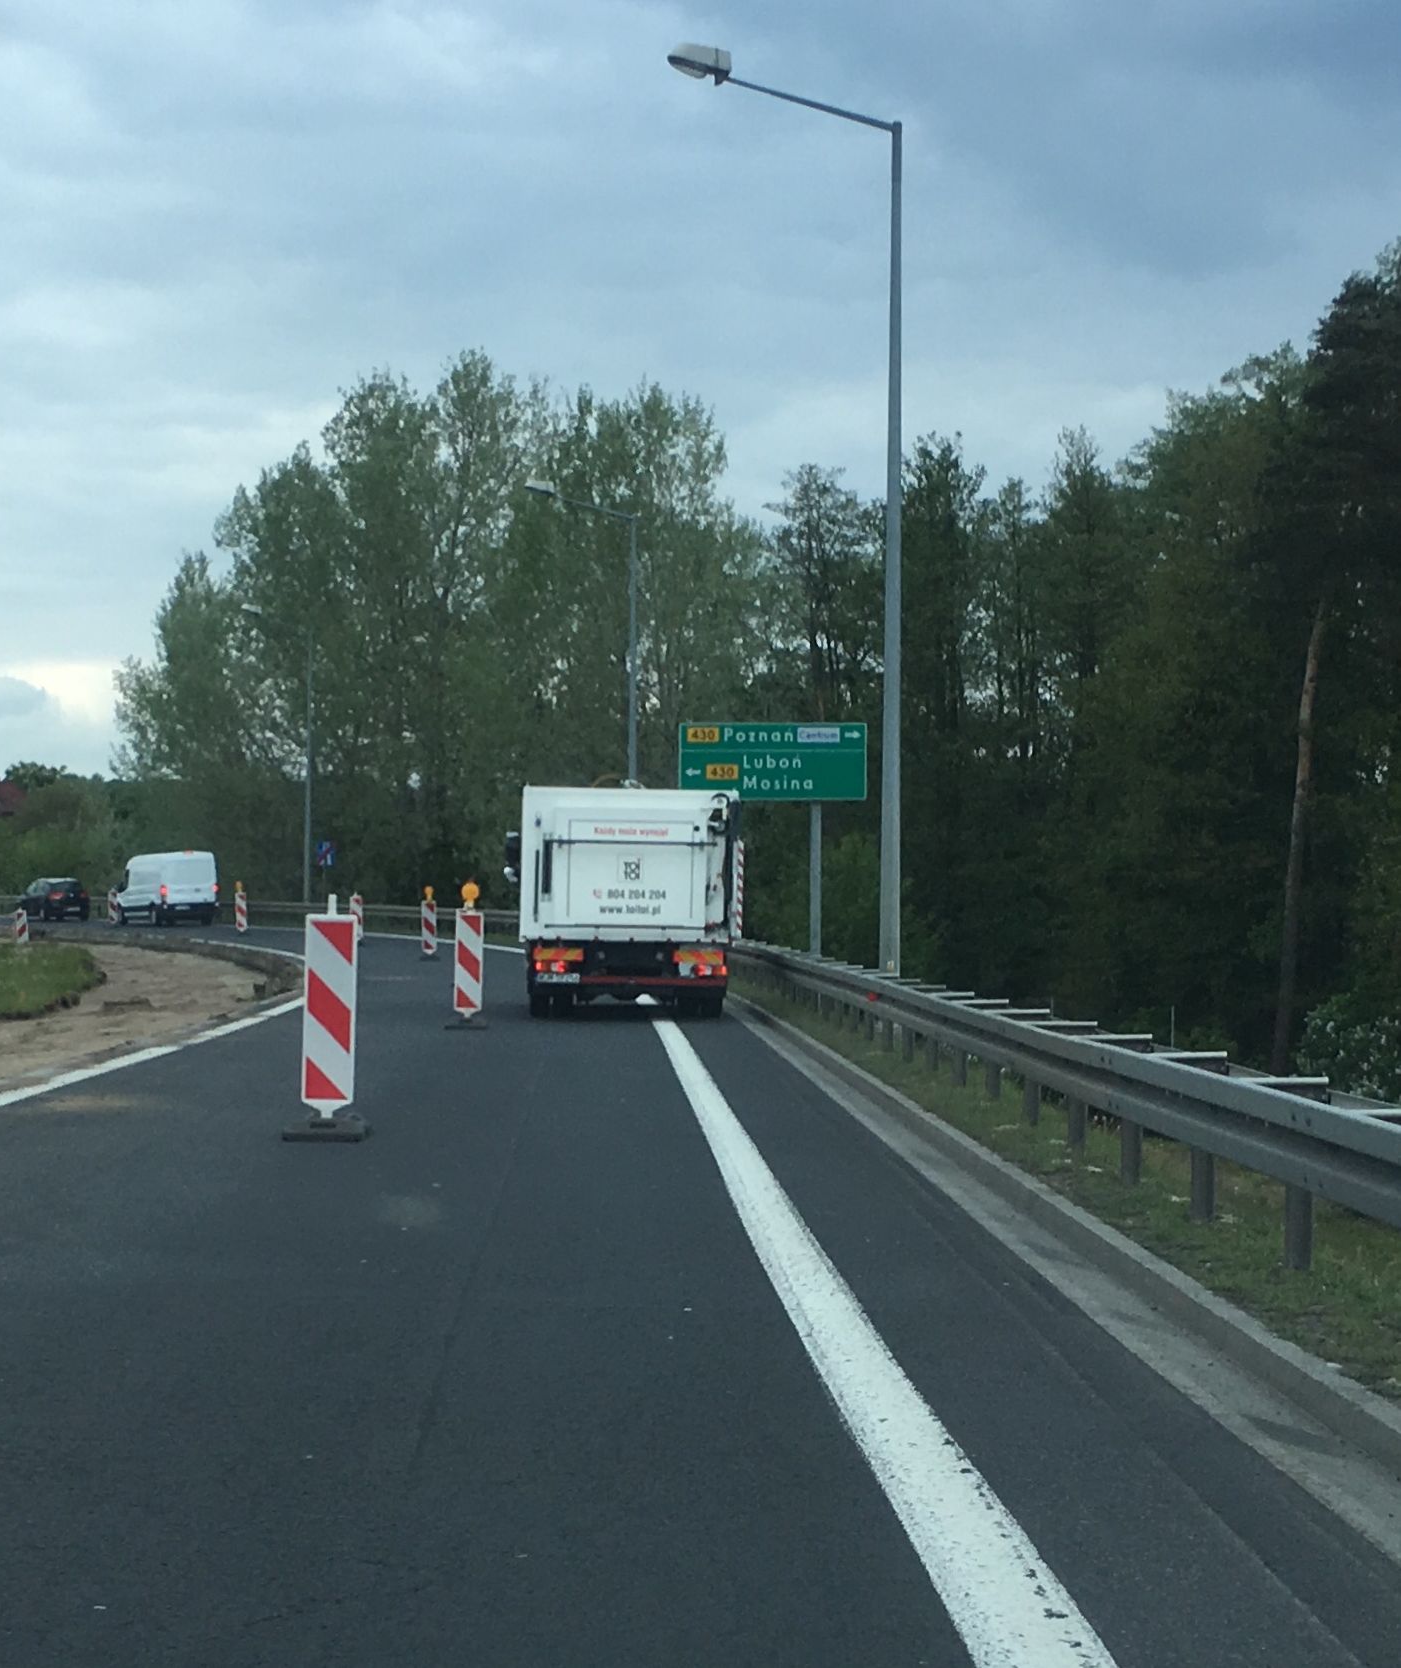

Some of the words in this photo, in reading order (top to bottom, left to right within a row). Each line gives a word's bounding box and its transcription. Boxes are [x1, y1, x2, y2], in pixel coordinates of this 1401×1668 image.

[691, 729, 716, 740] 430
[724, 727, 793, 743] Poznań
[799, 728, 838, 740] Centrum
[743, 753, 802, 769] Luboń
[710, 766, 735, 778] 430
[743, 775, 814, 790] Mosina
[628, 889, 646, 899] 204
[649, 890, 667, 900] 204
[599, 904, 661, 916] www.toitoi.pl
